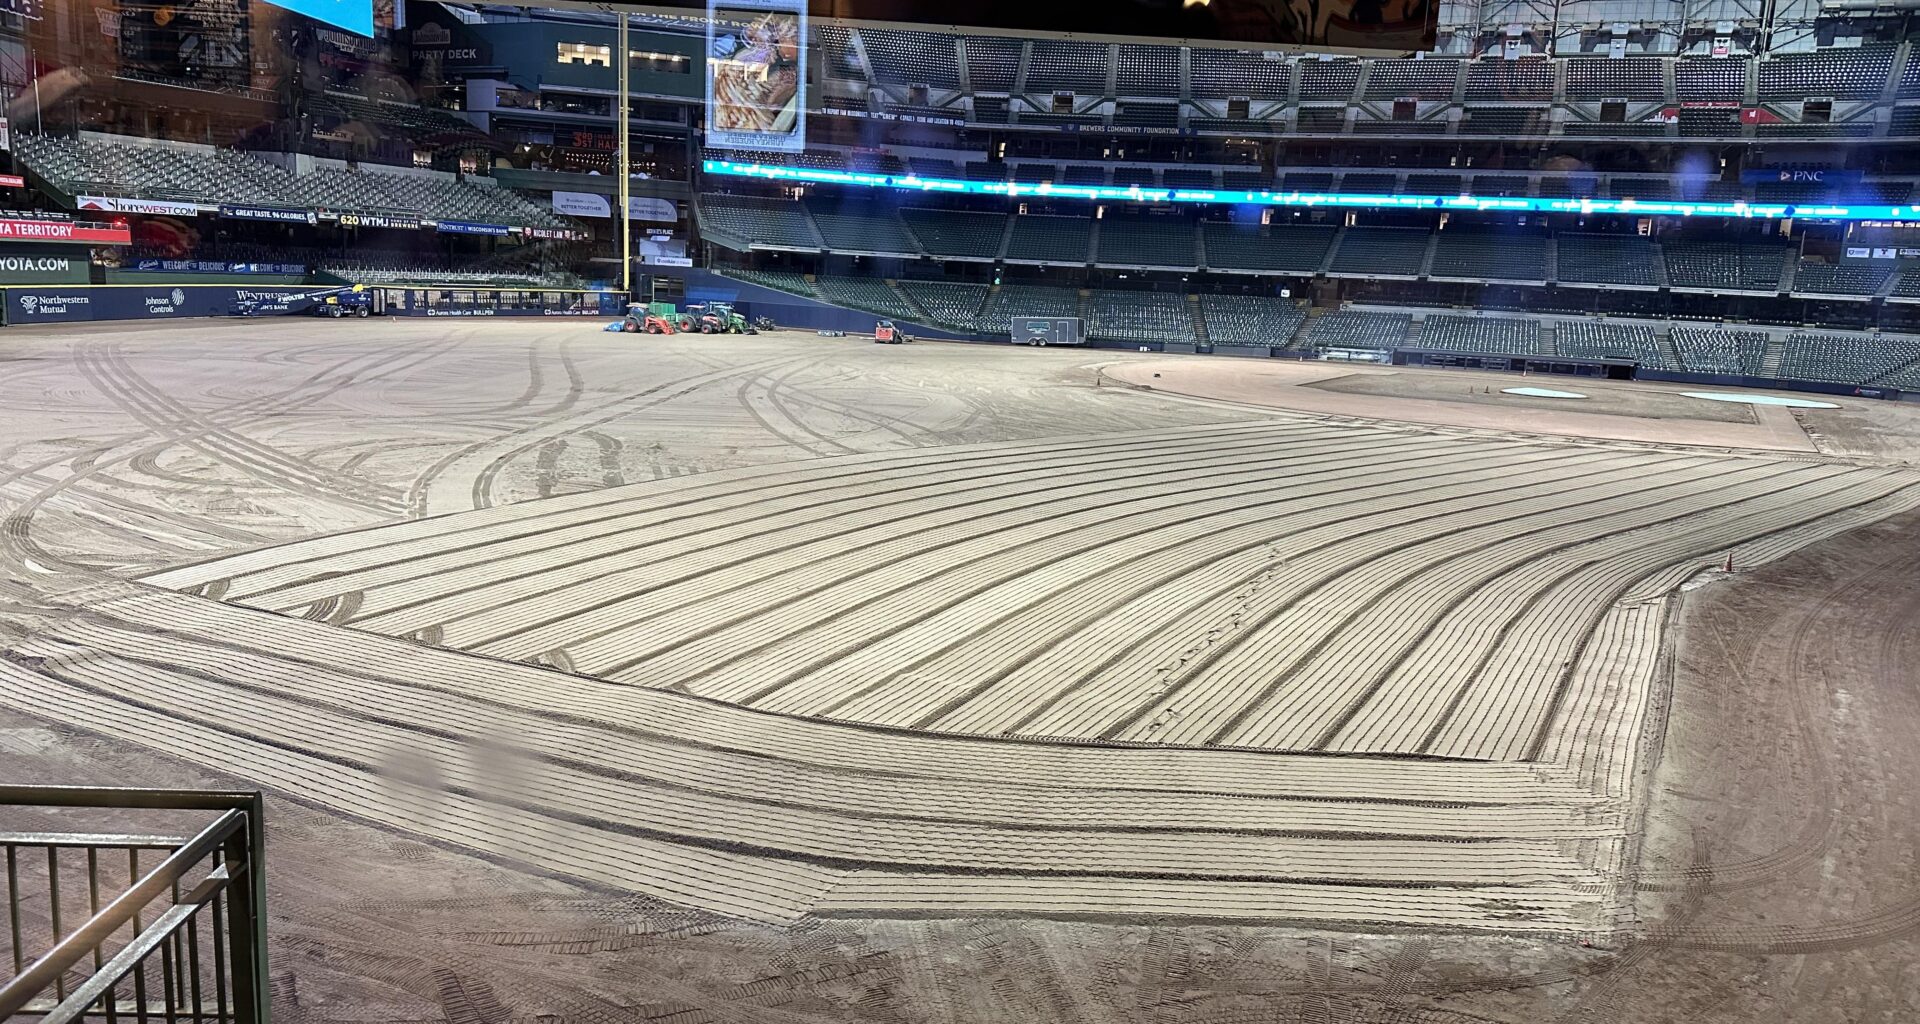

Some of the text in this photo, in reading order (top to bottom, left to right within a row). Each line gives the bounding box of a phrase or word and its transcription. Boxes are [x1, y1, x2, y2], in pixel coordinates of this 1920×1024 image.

[681, 15, 728, 26] FRONT
[412, 49, 477, 60] PARTY DECK
[1144, 126, 1180, 134] FOUNDATION
[1794, 170, 1824, 181] PNC
[340, 215, 359, 225] 620
[360, 216, 389, 226] WTMJ
[14, 224, 73, 236] TERRITORY
[468, 226, 495, 234] WISCONSIN'S
[534, 229, 563, 239] NICOLET LAW
[162, 260, 189, 270] WELCOME
[198, 262, 225, 271] DELICIOUS
[250, 263, 274, 272] WELCOME
[281, 264, 304, 273] DELICIOUS
[39, 296, 89, 304] Northwestern
[145, 297, 169, 306] Johnson
[40, 305, 67, 314] Mutual
[150, 305, 174, 313] Controls
